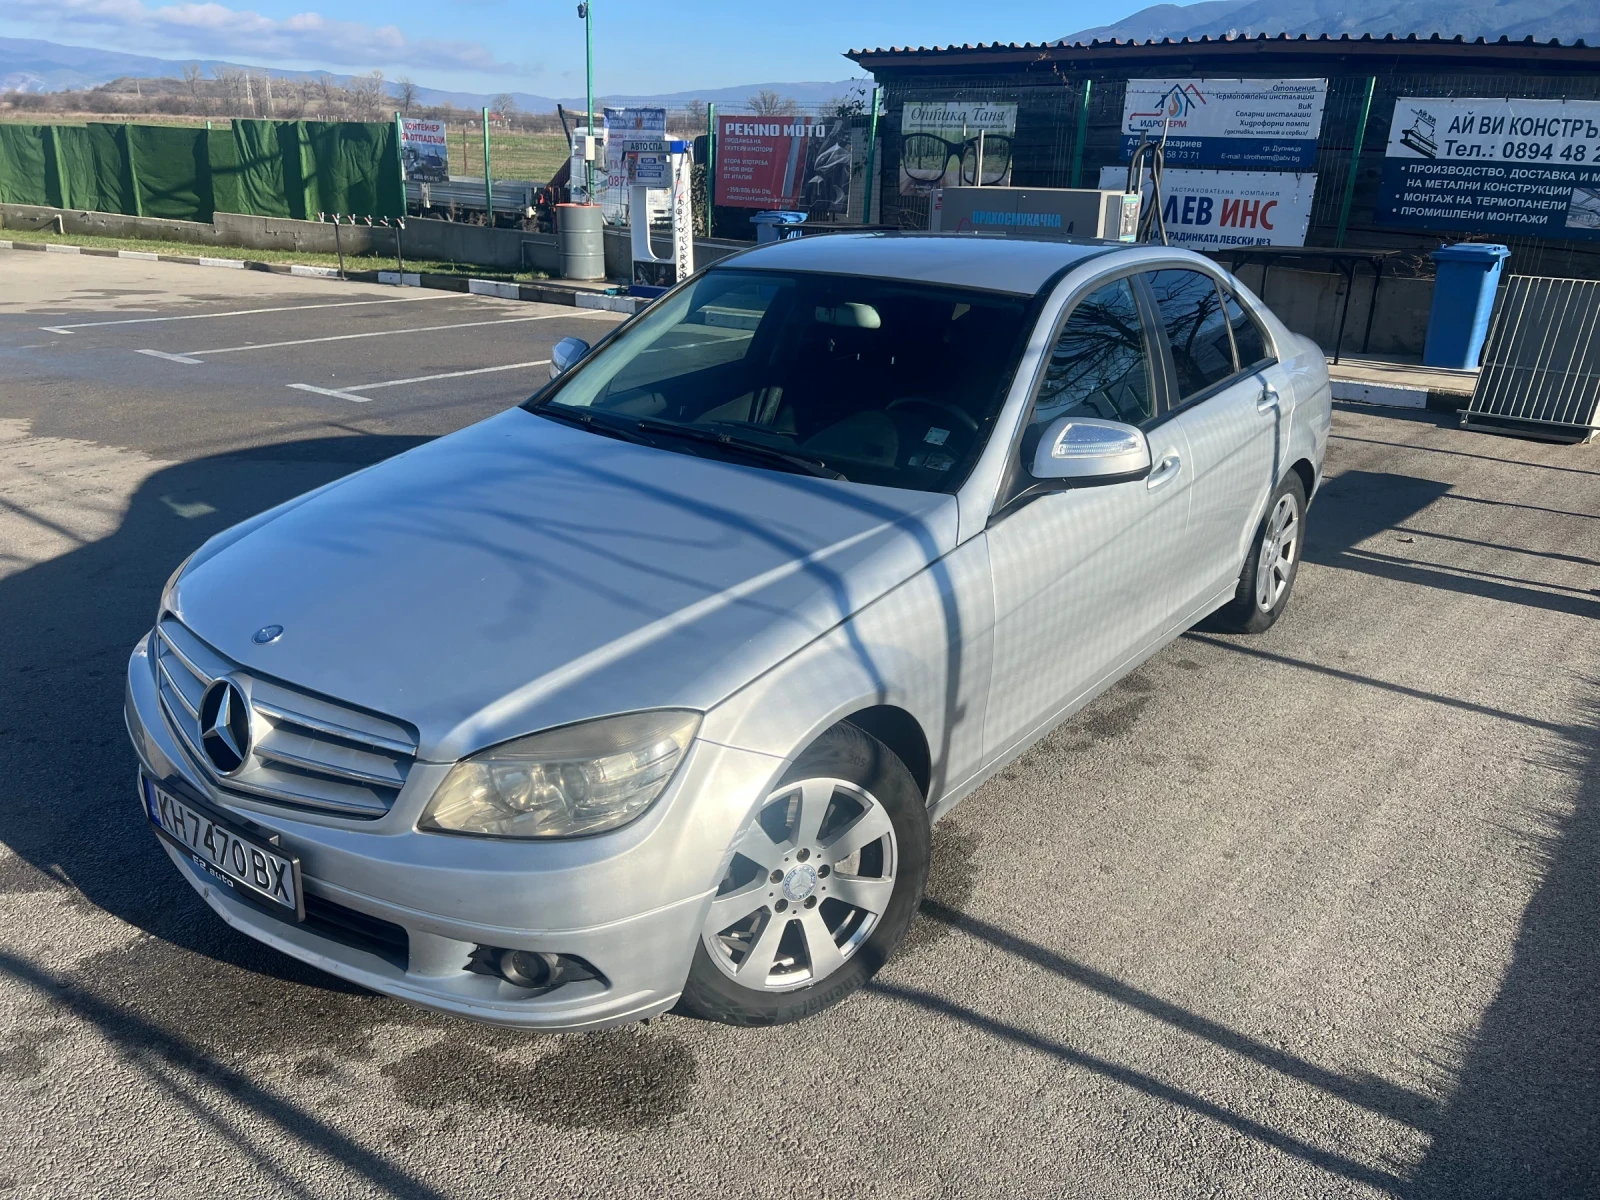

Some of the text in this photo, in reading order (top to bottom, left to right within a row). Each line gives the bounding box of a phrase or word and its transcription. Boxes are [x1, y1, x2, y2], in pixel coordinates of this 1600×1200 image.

[1268, 94, 1315, 102] инсталации
[911, 107, 1007, 122] Оптика Таня
[1235, 110, 1312, 119] Соларни инсталации
[725, 122, 826, 138] PEKINO MOTO
[1239, 119, 1284, 129] Хидрофорни
[1448, 111, 1600, 139] АЙ ВИ КОНСТРЪ
[630, 143, 648, 151] АВТО
[649, 143, 663, 151] СПА
[1445, 139, 1495, 158] Тел.:
[1502, 142, 1553, 160] 0894
[1559, 144, 1586, 162] 48
[1178, 151, 1188, 159] 73
[1243, 154, 1300, 163] idrotherm@abv.bg
[1409, 164, 1507, 179] ПРОИЗВОДСТВО,
[1510, 169, 1576, 181] ДОСТАВКА
[1579, 173, 1589, 182] И
[1170, 187, 1234, 195] ЗАСТРАХОВАТЕЛНА
[1406, 179, 1572, 197] НА МЕТАЛНИ КОНСТРУКЦИИ
[1404, 192, 1568, 211] МОНТАЖ НА ТЕРМОПАНЕЛИ
[1163, 195, 1278, 230] ЛЕВ ИНС
[1401, 206, 1549, 225] ПРОМИШЛЕНИ МОНТАЖИ
[1166, 232, 1219, 244] ГРАДИНКАТА
[1220, 235, 1254, 246] ЛЕВСКИ
[209, 868, 234, 888] auto
